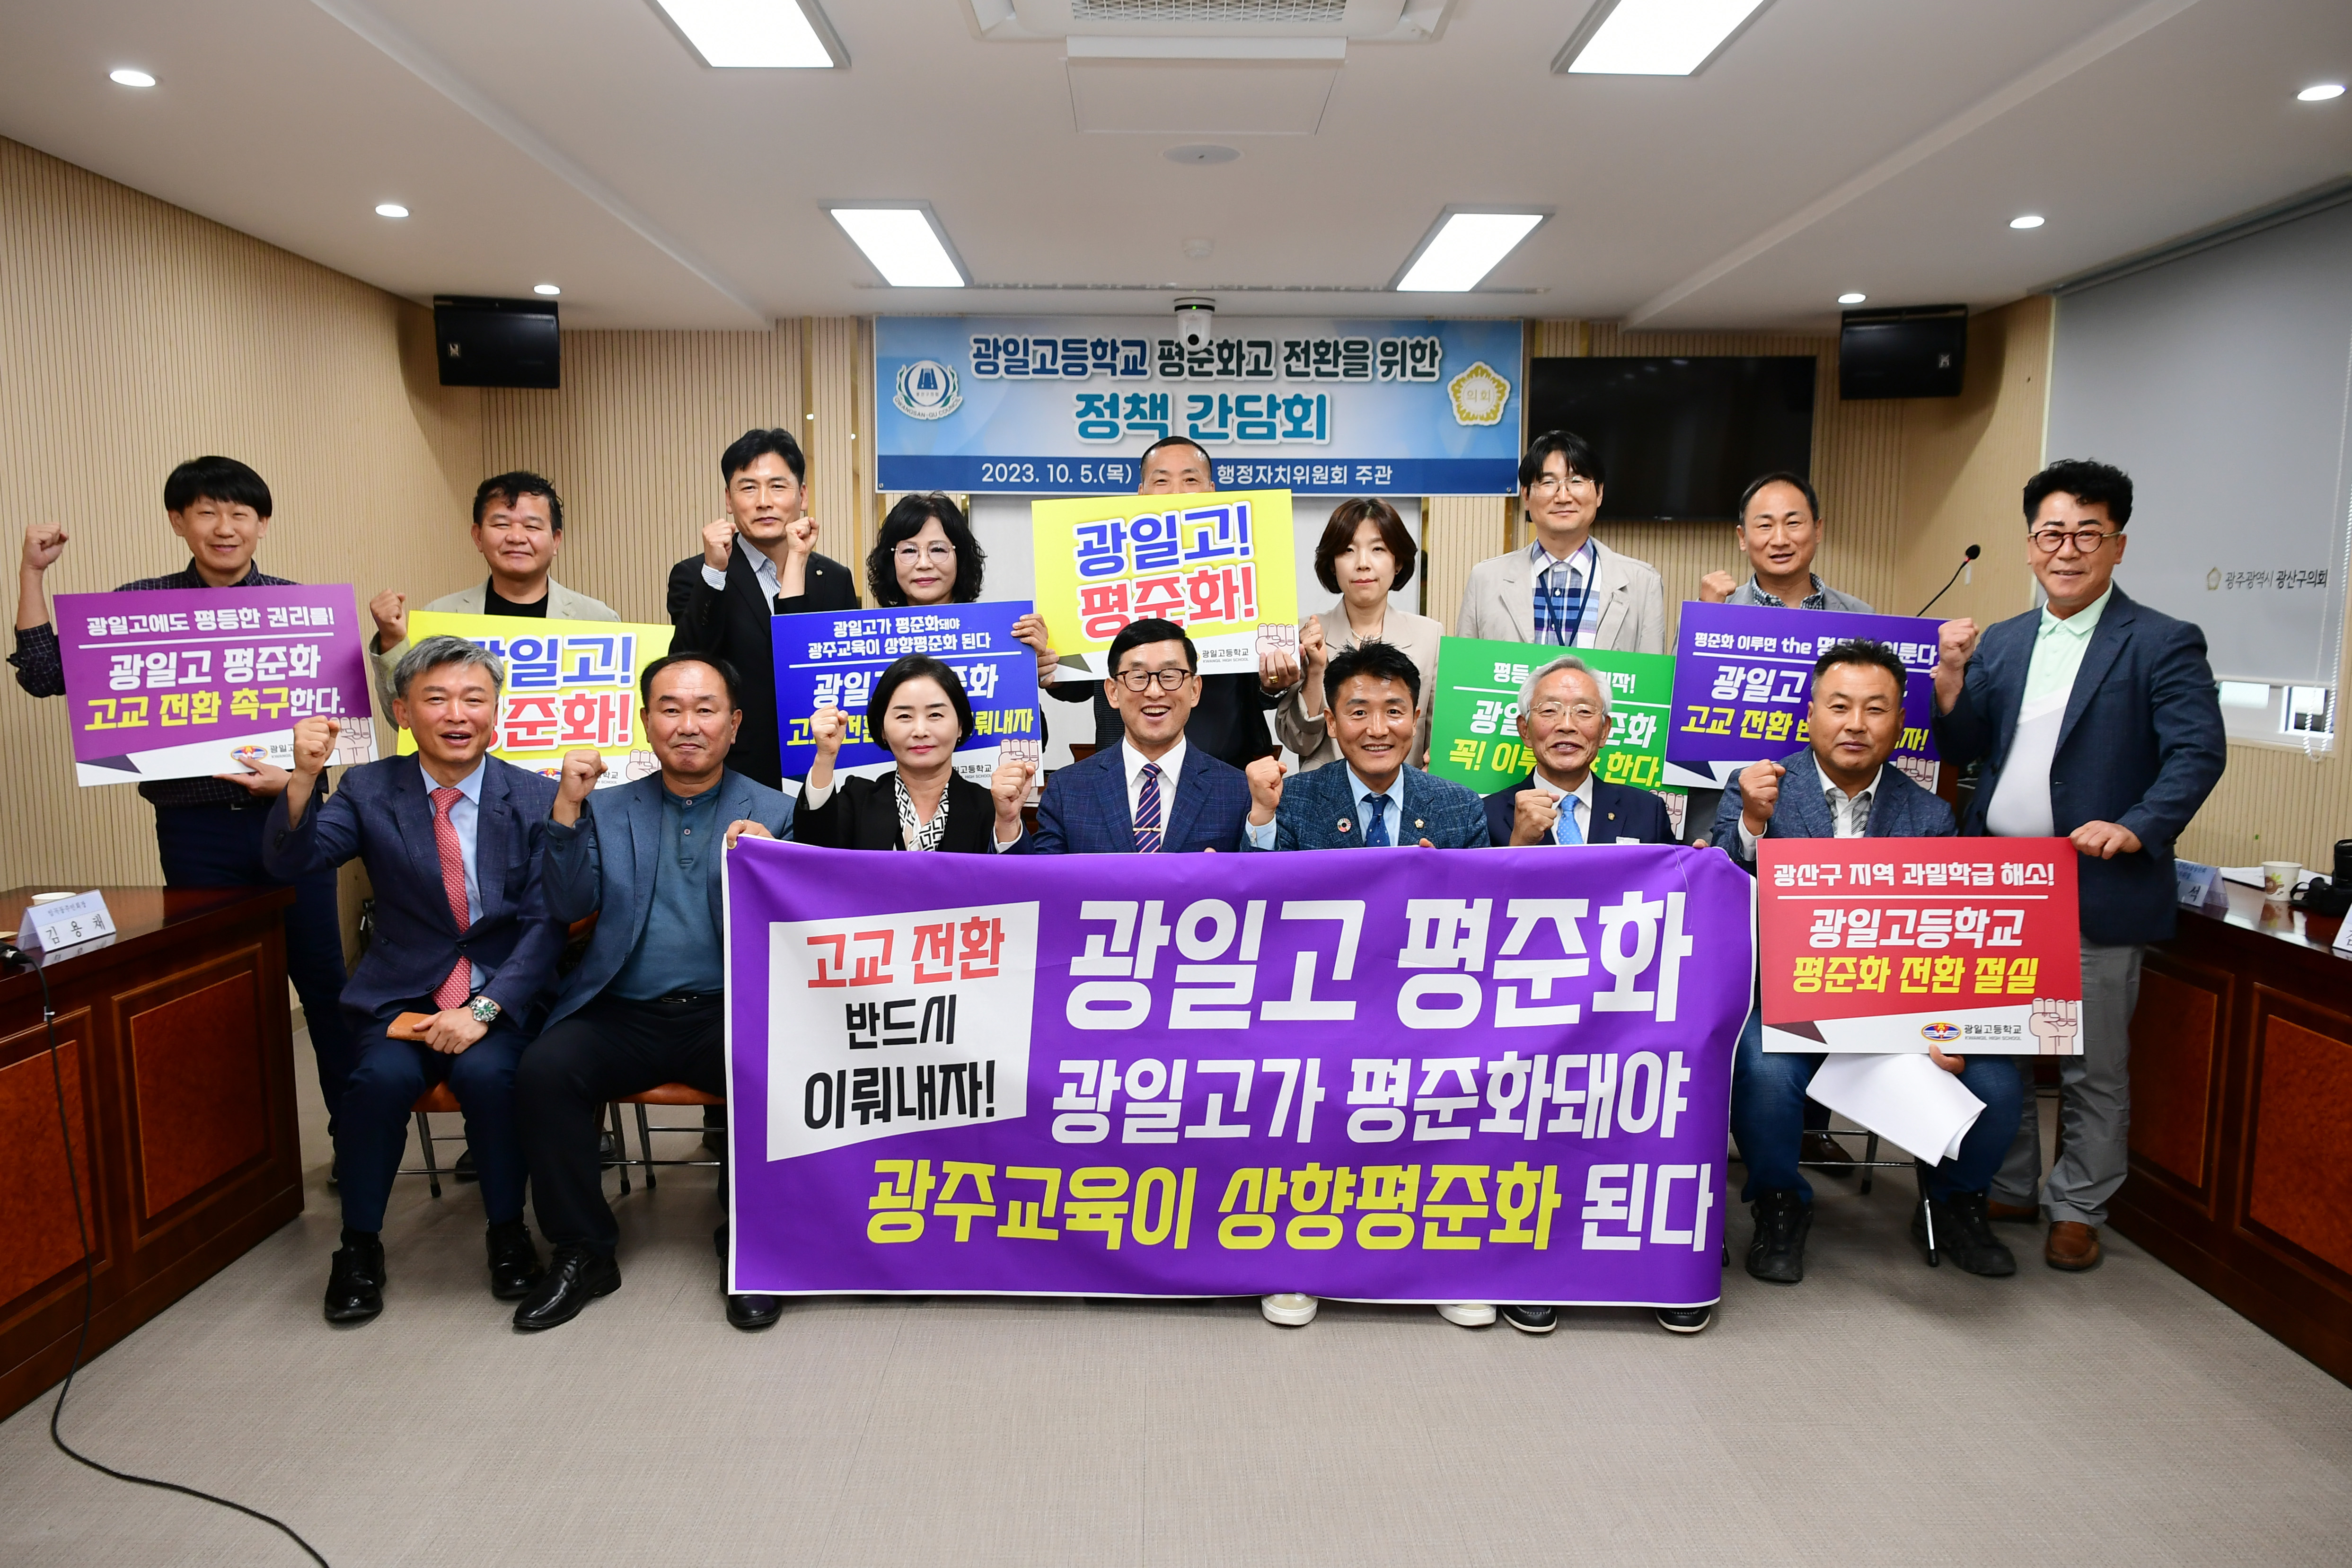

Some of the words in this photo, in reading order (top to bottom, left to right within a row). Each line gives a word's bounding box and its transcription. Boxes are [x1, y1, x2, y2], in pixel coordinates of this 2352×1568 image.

[972, 338, 1149, 376] 광일고등학교
[1157, 338, 1274, 377] 평준화고
[1284, 339, 1370, 378] 전환을
[1380, 339, 1439, 378] 위한
[1075, 392, 1169, 439] 정책
[1186, 393, 1326, 440] 간담회
[981, 463, 1039, 483] 2023.
[1047, 463, 1073, 483] 10.
[1216, 464, 1348, 485] 행정자치위원회
[1355, 465, 1393, 485] 주관
[1076, 504, 1250, 577] 광일고!
[2226, 571, 2273, 589] 광주광역시
[2276, 569, 2328, 589] 광산구의회
[86, 613, 190, 636] 광일고에도
[194, 607, 261, 631] 평등한
[266, 606, 335, 628] 권리를!
[1080, 566, 1255, 639] 평준화!
[808, 638, 880, 660] 광주교육이
[884, 634, 958, 654] 상향평준화
[961, 632, 992, 650] 된다
[833, 618, 892, 638] 광일고가
[895, 615, 960, 634] 평준화돼야
[1694, 632, 1735, 650] 평준화
[1737, 635, 1777, 653] 이루면
[1781, 636, 1812, 655] the
[109, 650, 212, 691] 광일고
[223, 643, 321, 683] 평준화
[1202, 648, 1249, 658] 광일고등학교
[813, 671, 885, 708] 광일
[1493, 662, 1529, 684] 평등
[1711, 665, 1807, 704] 광일고
[84, 696, 150, 731] 고교
[159, 689, 222, 727] 전환
[229, 687, 345, 721] 촉구한다.
[488, 693, 630, 748] 준화!
[970, 708, 1034, 736] 뤄내자
[1680, 705, 1735, 735] 고교
[1739, 709, 1794, 741] 전환
[270, 744, 294, 753] 광일고
[1449, 739, 1487, 771] 꼭!
[1603, 751, 1661, 787] 한다.
[952, 764, 992, 774] 일고등학교
[1773, 863, 1842, 888] 광산구
[1849, 863, 1894, 886] 지역
[1901, 861, 1995, 886] 과밀학급
[2000, 862, 2054, 886] 해소!
[1808, 907, 2025, 949] 광일고등학교
[806, 929, 894, 988] 고교
[911, 916, 1005, 985] 전환
[1065, 898, 1366, 1030] 광일고
[1396, 890, 1694, 1030] 평준화
[1792, 955, 1891, 994] 평준화
[1899, 955, 1965, 994] 전환
[1974, 957, 2040, 995] 절실
[846, 994, 957, 1050] 반드시
[1964, 1024, 2022, 1035] 광일고등학교
[804, 1059, 995, 1129] 이뤄내자!
[1051, 1057, 1326, 1144] 광일고가
[1346, 1050, 1691, 1144] 평준화돼야
[867, 1158, 1198, 1251] 광주교육이
[1217, 1161, 1562, 1251] 상향평준화
[1581, 1163, 1714, 1252] 된다
